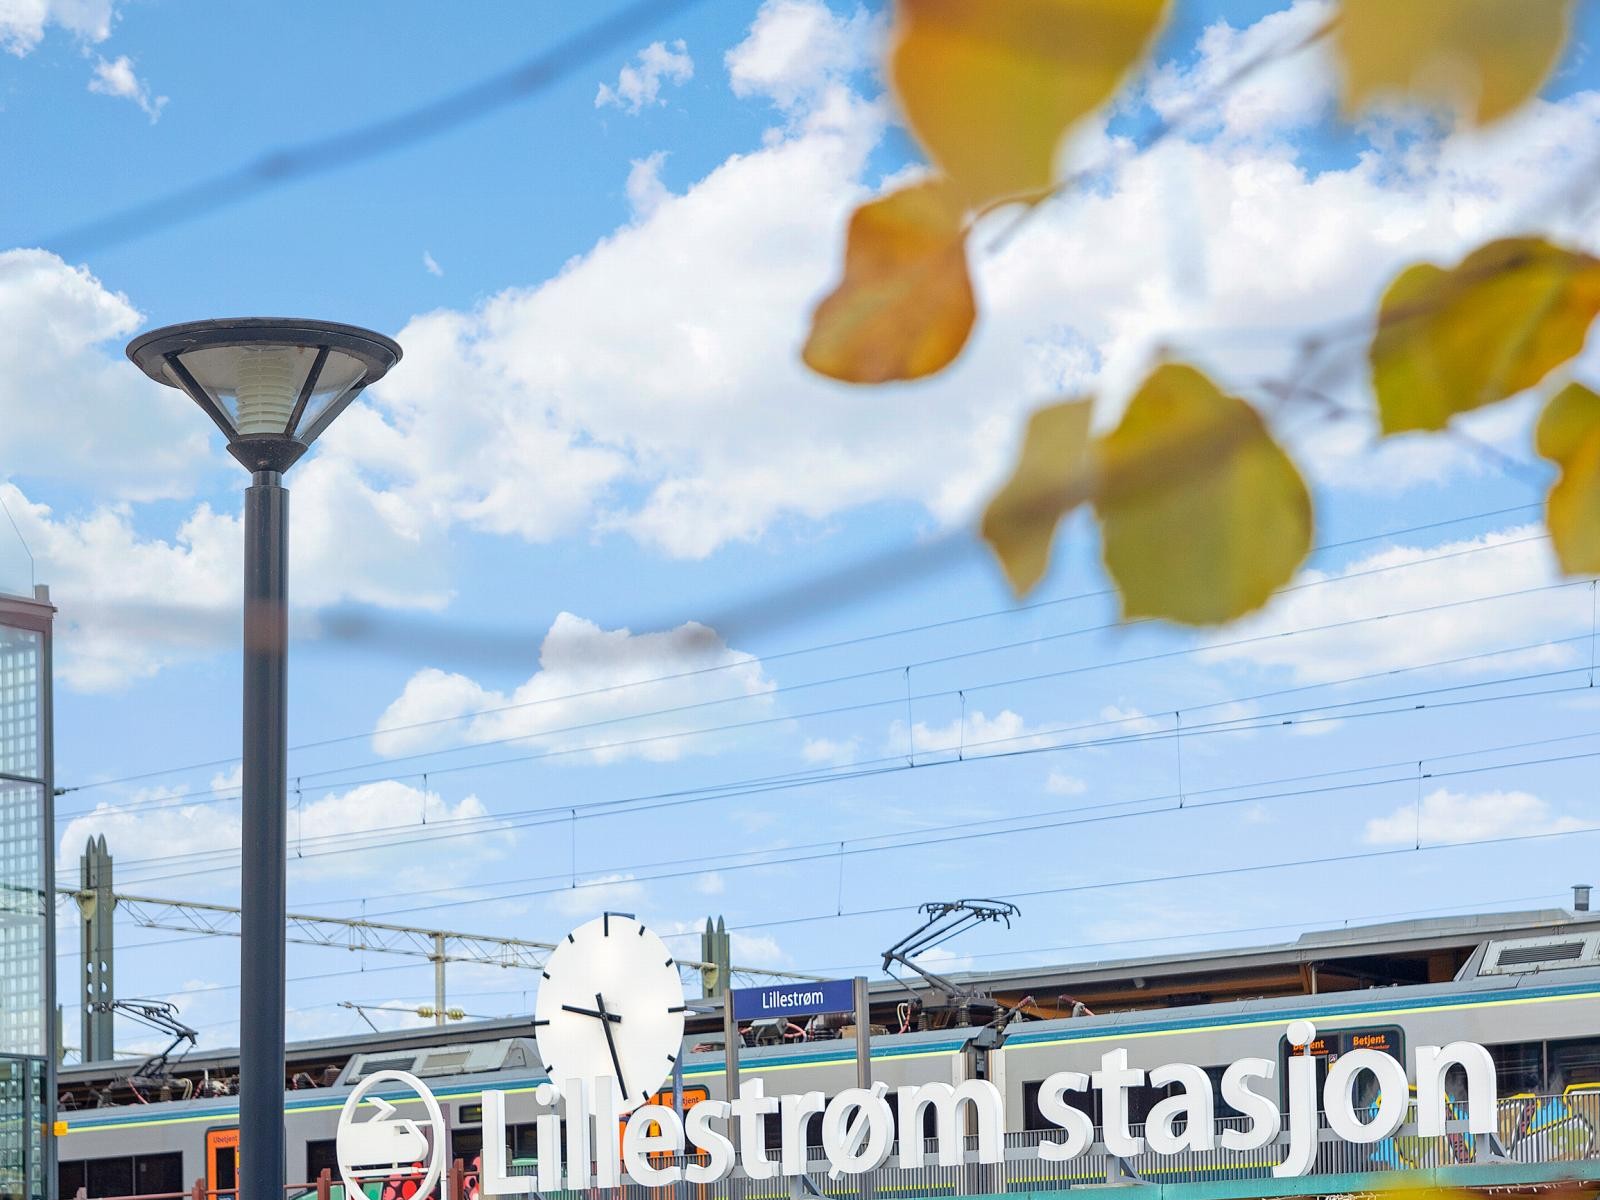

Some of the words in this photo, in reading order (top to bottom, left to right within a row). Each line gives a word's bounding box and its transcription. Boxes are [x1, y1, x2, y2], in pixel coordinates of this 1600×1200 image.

[762, 991, 824, 1008] Lillestrøm
[1353, 1035, 1385, 1046] Betjent
[482, 1075, 1004, 1194] Lillestrøm
[1038, 1020, 1497, 1178] stasjon
